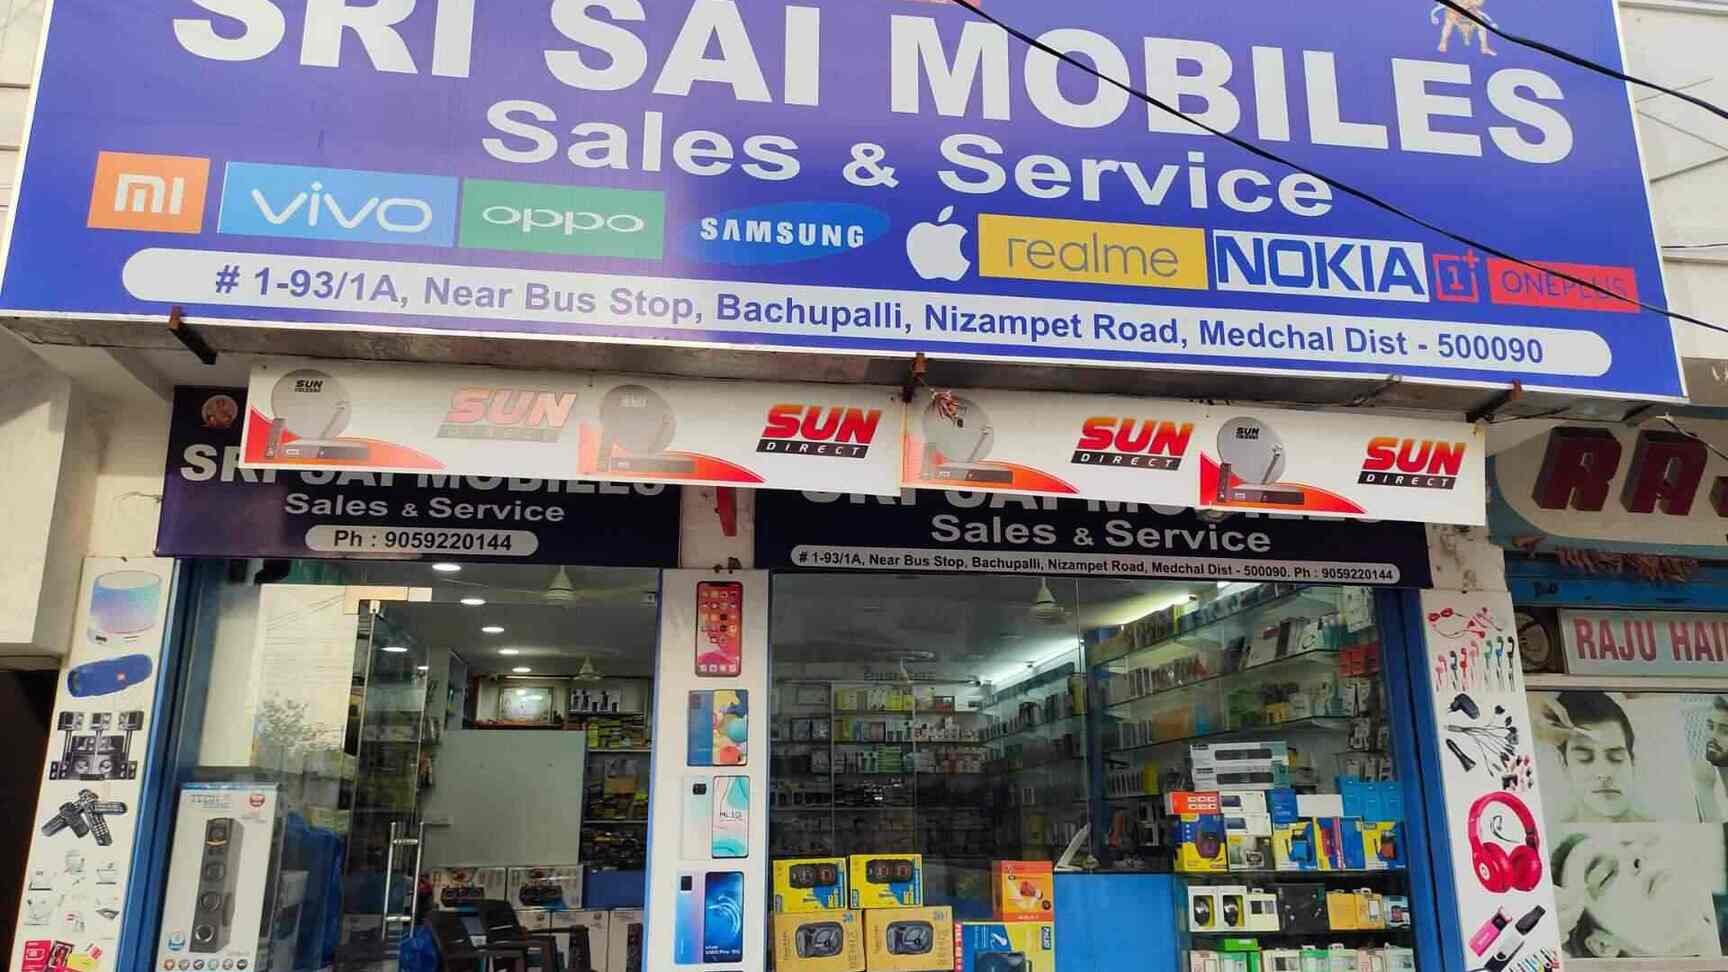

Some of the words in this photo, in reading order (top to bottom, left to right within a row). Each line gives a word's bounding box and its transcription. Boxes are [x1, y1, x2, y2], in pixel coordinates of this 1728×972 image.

[173, 0, 475, 77] SRI
[545, 0, 820, 105] SAI
[890, 14, 1574, 164] MOBILES
[481, 99, 801, 181] Sales
[843, 142, 898, 188] &
[938, 133, 1333, 217] Service
[251, 181, 433, 233] vivo
[482, 204, 645, 236] oppo
[700, 216, 864, 249] SAMSUNG
[1006, 234, 1179, 279] realme
[1215, 235, 1426, 296] NOKIA
[1502, 270, 1627, 300] ONEPLUS
[215, 265, 240, 294] #
[253, 265, 408, 307] 1-93/1A,
[425, 276, 520, 309] Near
[525, 282, 597, 315] Bus
[609, 286, 703, 325] Stop,
[716, 293, 911, 333] Bachupalli,
[925, 304, 1081, 341] Nizampet
[1094, 313, 1187, 349] Road,
[1200, 318, 1333, 352] Medchal
[1345, 325, 1408, 356] Dist
[1438, 333, 1544, 364] 500090
[447, 385, 577, 428] SUN
[762, 404, 882, 443] SUN
[766, 442, 861, 456] DIRECT
[1075, 416, 1194, 456] SUN
[1363, 436, 1466, 475] SUN
[1080, 453, 1175, 468] DIRECT
[1366, 473, 1450, 488] DIRECT
[285, 493, 389, 517] Sales
[402, 503, 418, 518] &
[428, 497, 565, 522] Service
[334, 530, 362, 548] Ph
[384, 532, 512, 552] 9059220144
[931, 514, 1057, 545] Sales
[1073, 527, 1094, 546] &
[1105, 519, 1272, 552] Service
[869, 553, 900, 566] Near
[904, 554, 930, 567] Bus
[1048, 559, 1108, 575] Nizampet
[1152, 562, 1204, 576] Medchal
[1208, 563, 1232, 577] Dist
[1294, 567, 1311, 580] Ph
[1322, 567, 1393, 582] 9059220144
[1573, 618, 1657, 661] RAJU
